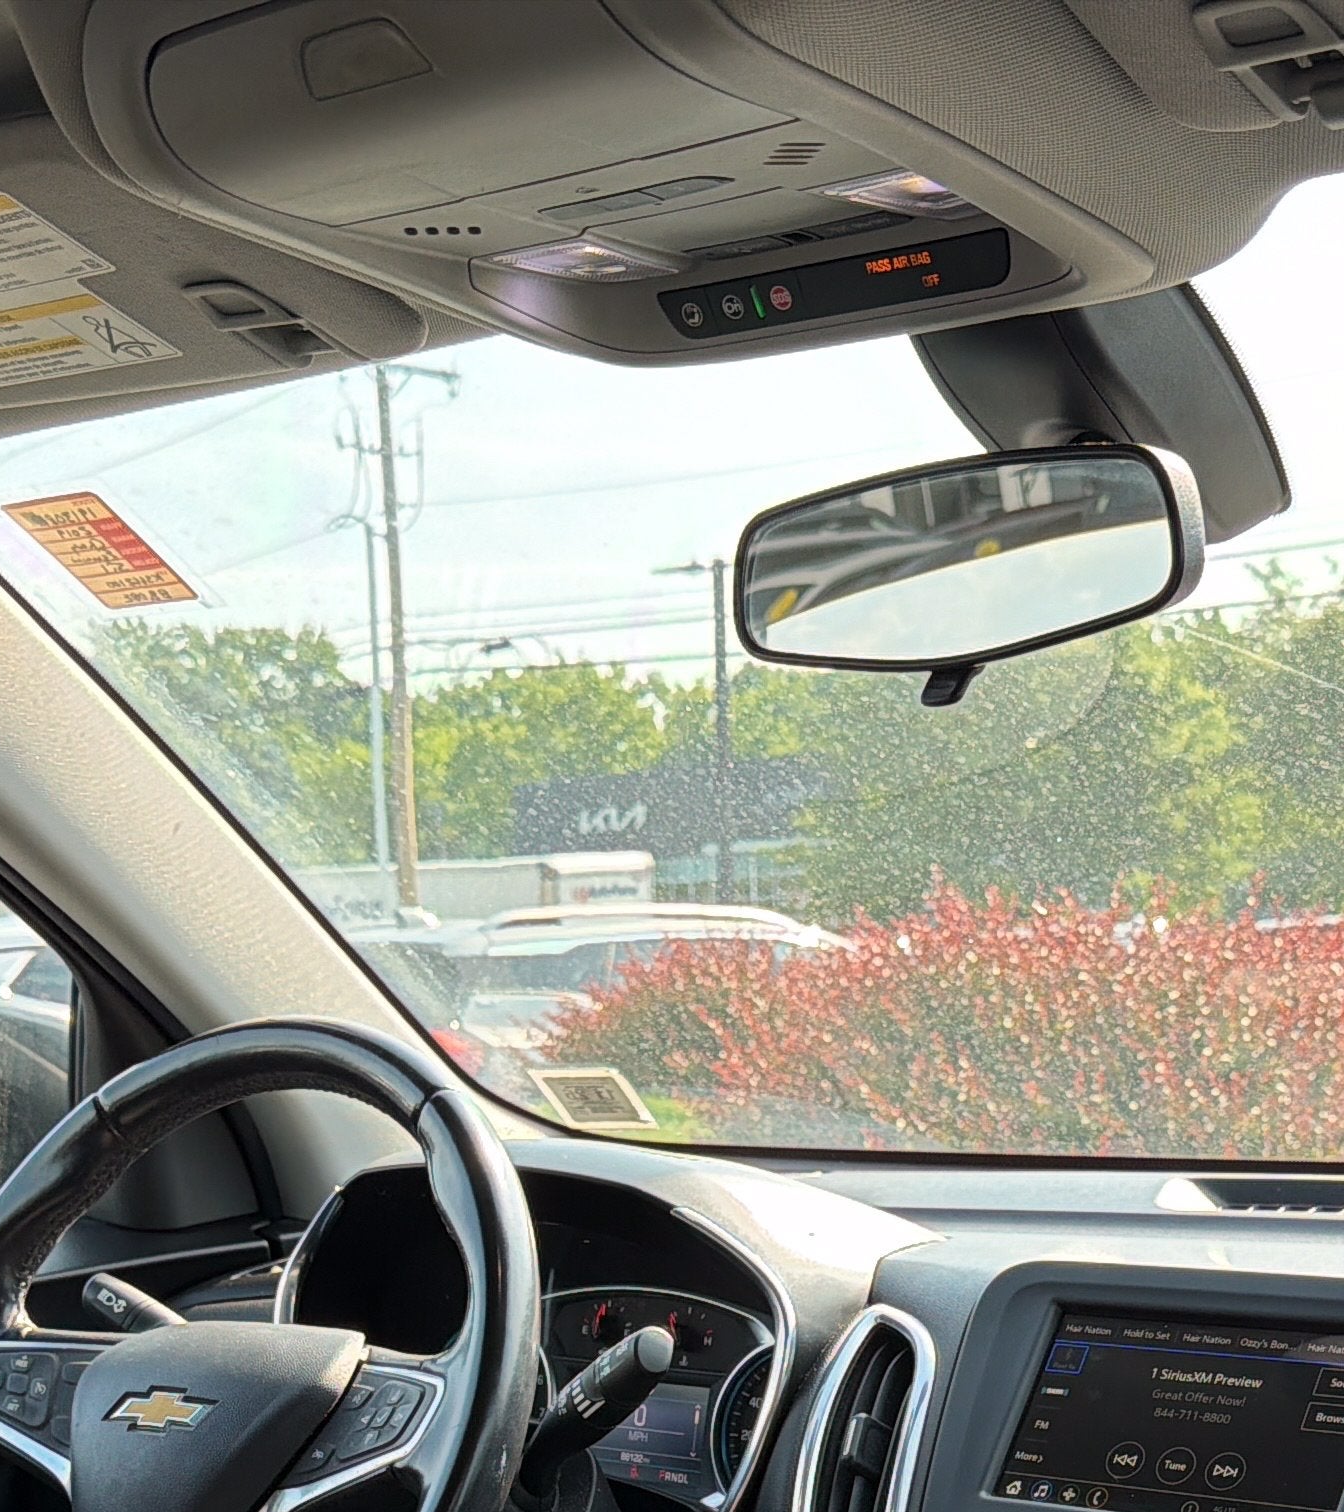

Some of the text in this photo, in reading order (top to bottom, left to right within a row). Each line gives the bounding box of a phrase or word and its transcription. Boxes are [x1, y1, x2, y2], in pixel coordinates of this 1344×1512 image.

[866, 251, 932, 275] PASS AIR BAG
[920, 274, 941, 288] OFF
[1065, 1324, 1112, 1336] Hair Nation
[1123, 1328, 1172, 1341] Hold to Set
[1182, 1333, 1232, 1346] Hair Nation
[1240, 1337, 1268, 1349] Ozzy's
[1307, 1343, 1326, 1353] Hair
[1160, 1368, 1213, 1384] SiriusXM
[1214, 1373, 1264, 1388] Preview
[1152, 1388, 1247, 1408] Great Offer Now!
[1153, 1407, 1232, 1425] 844-711-8800
[1034, 1419, 1050, 1430] FM
[1164, 1459, 1187, 1472] Tune
